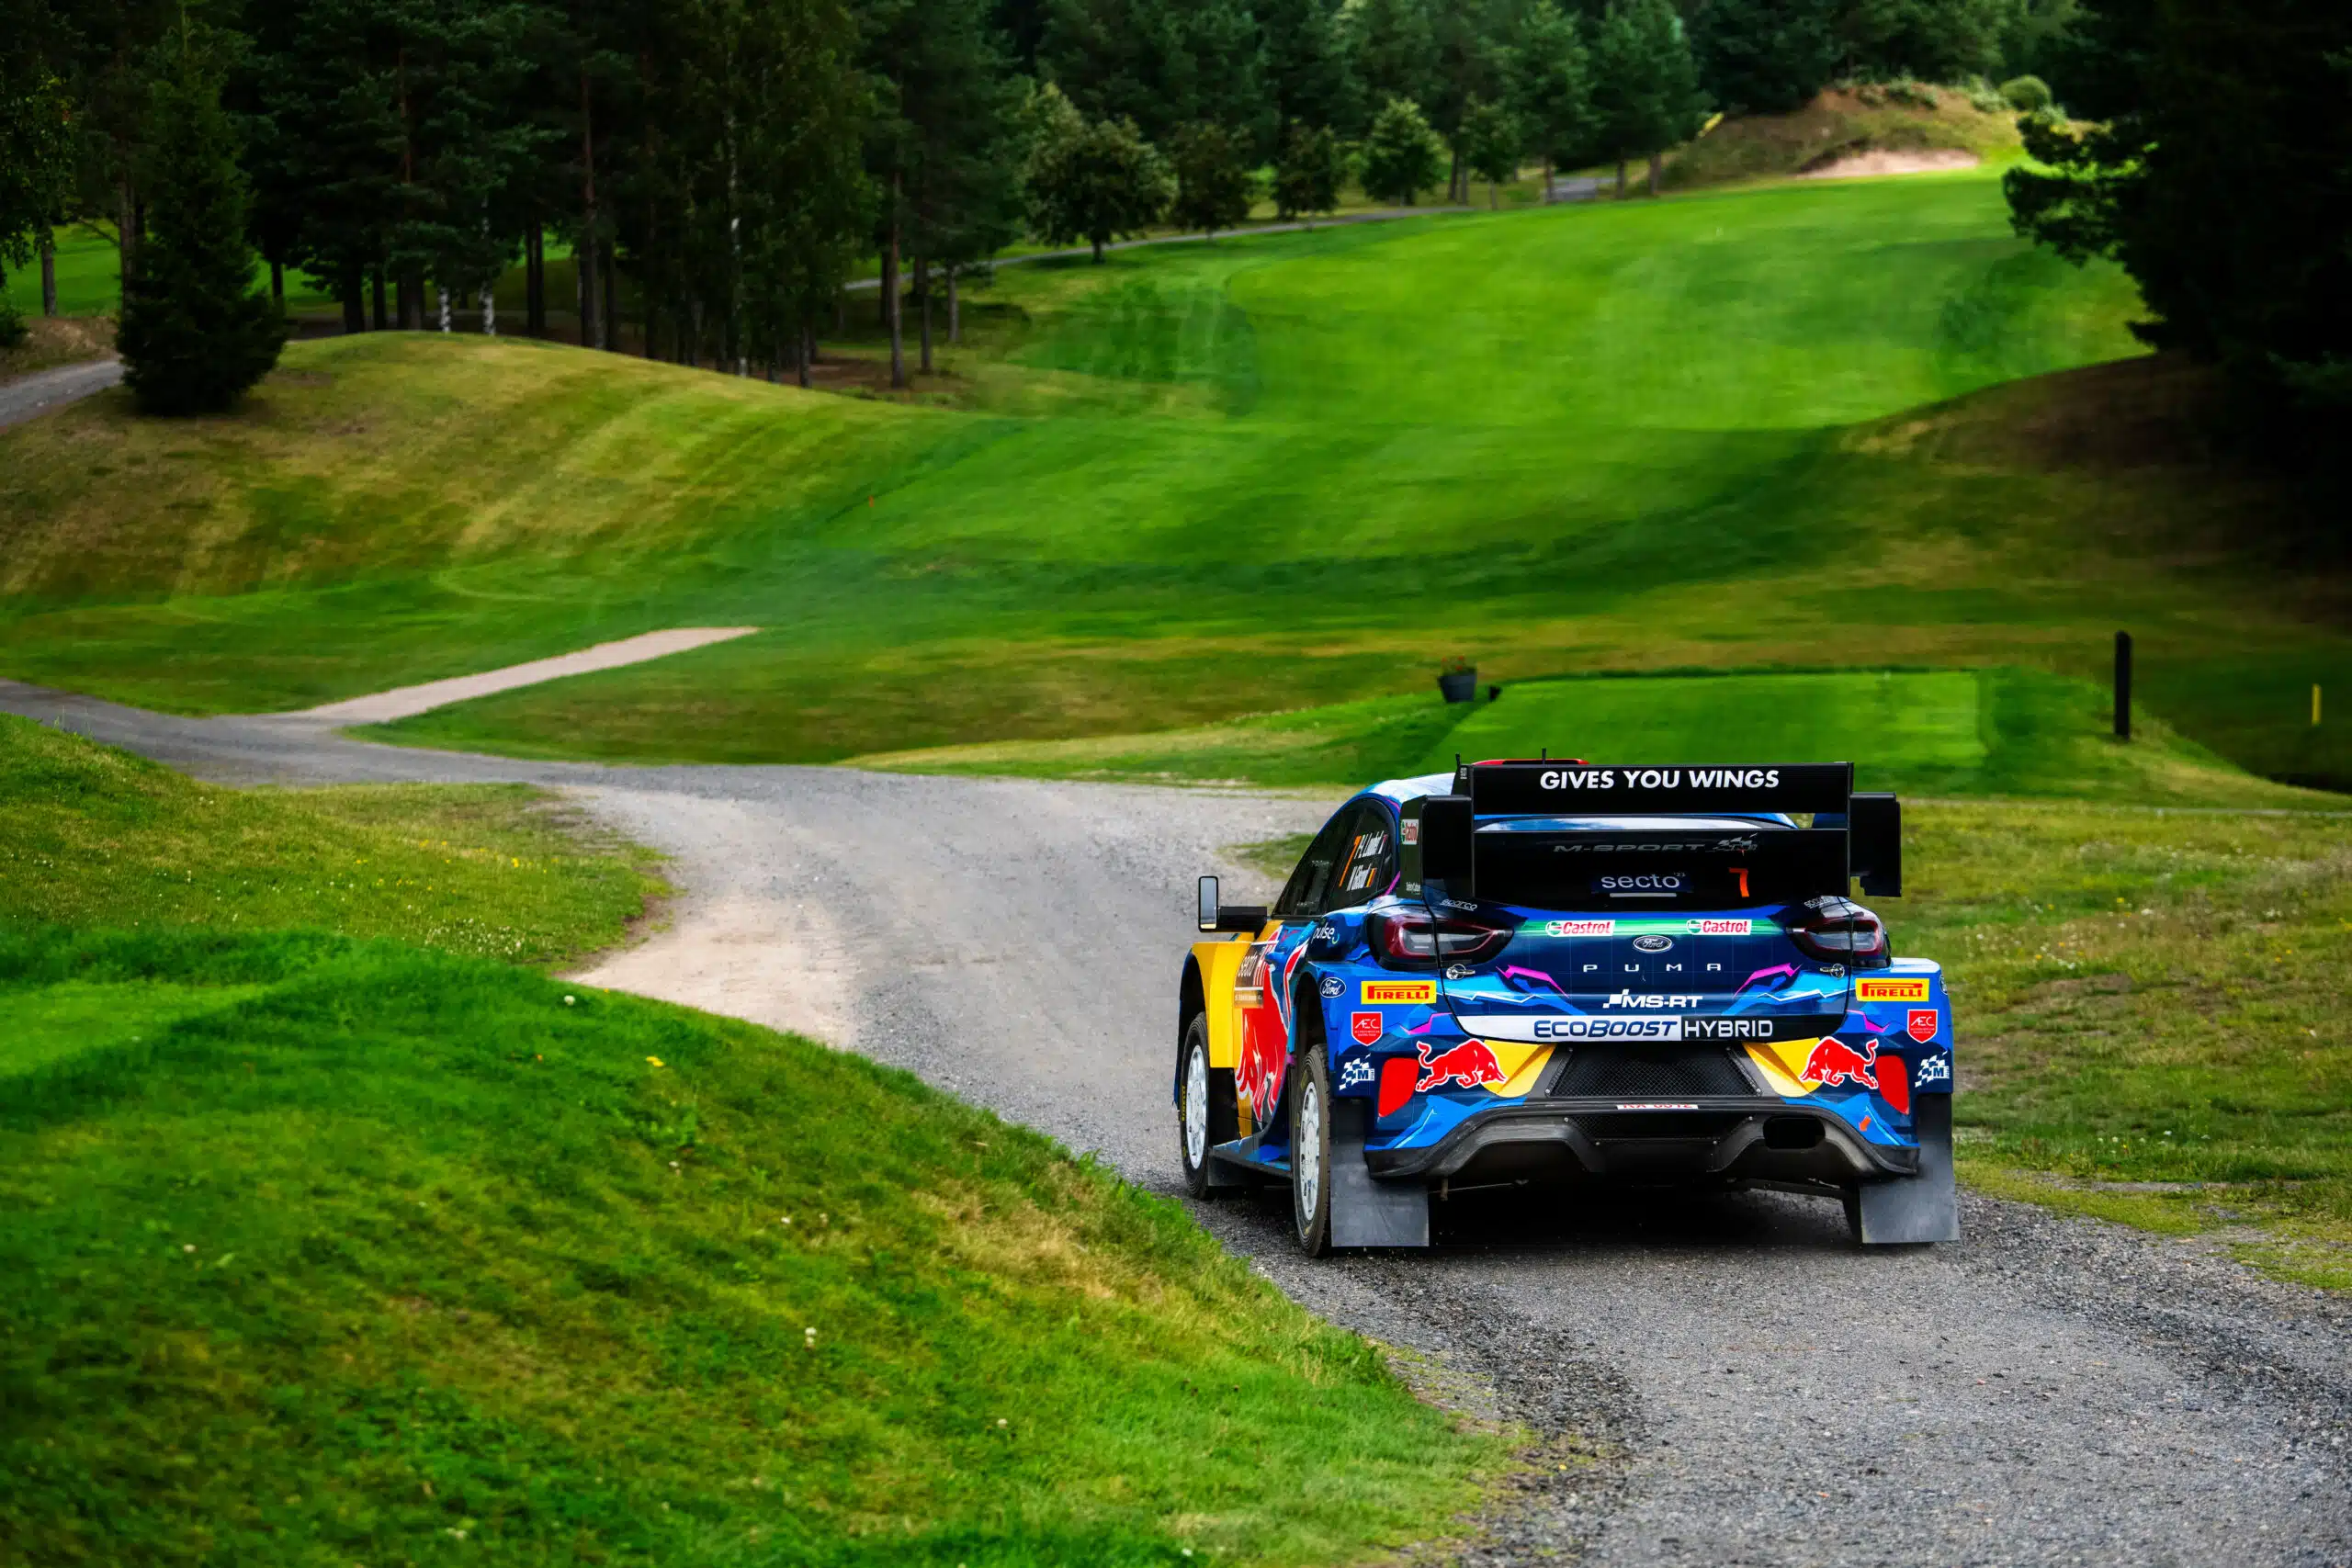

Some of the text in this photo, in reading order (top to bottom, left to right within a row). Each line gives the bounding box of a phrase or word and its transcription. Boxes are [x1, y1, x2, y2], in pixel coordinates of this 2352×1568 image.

[1540, 769, 1780, 790] GIVES YOU WINGS
[1553, 843, 1705, 852] M-SPORT
[1600, 874, 1680, 889] secto
[1729, 867, 1749, 897] 7
[1311, 922, 1335, 943] pulse
[1562, 920, 1611, 934] Castrol
[1702, 919, 1748, 933] Castrol
[1582, 963, 1722, 973] PUMA
[1367, 985, 1430, 999] PIRELLI
[1861, 982, 1923, 997] PIRELLI
[1621, 994, 1702, 1008] MS-RT
[1684, 1020, 1773, 1037] HYBRID
